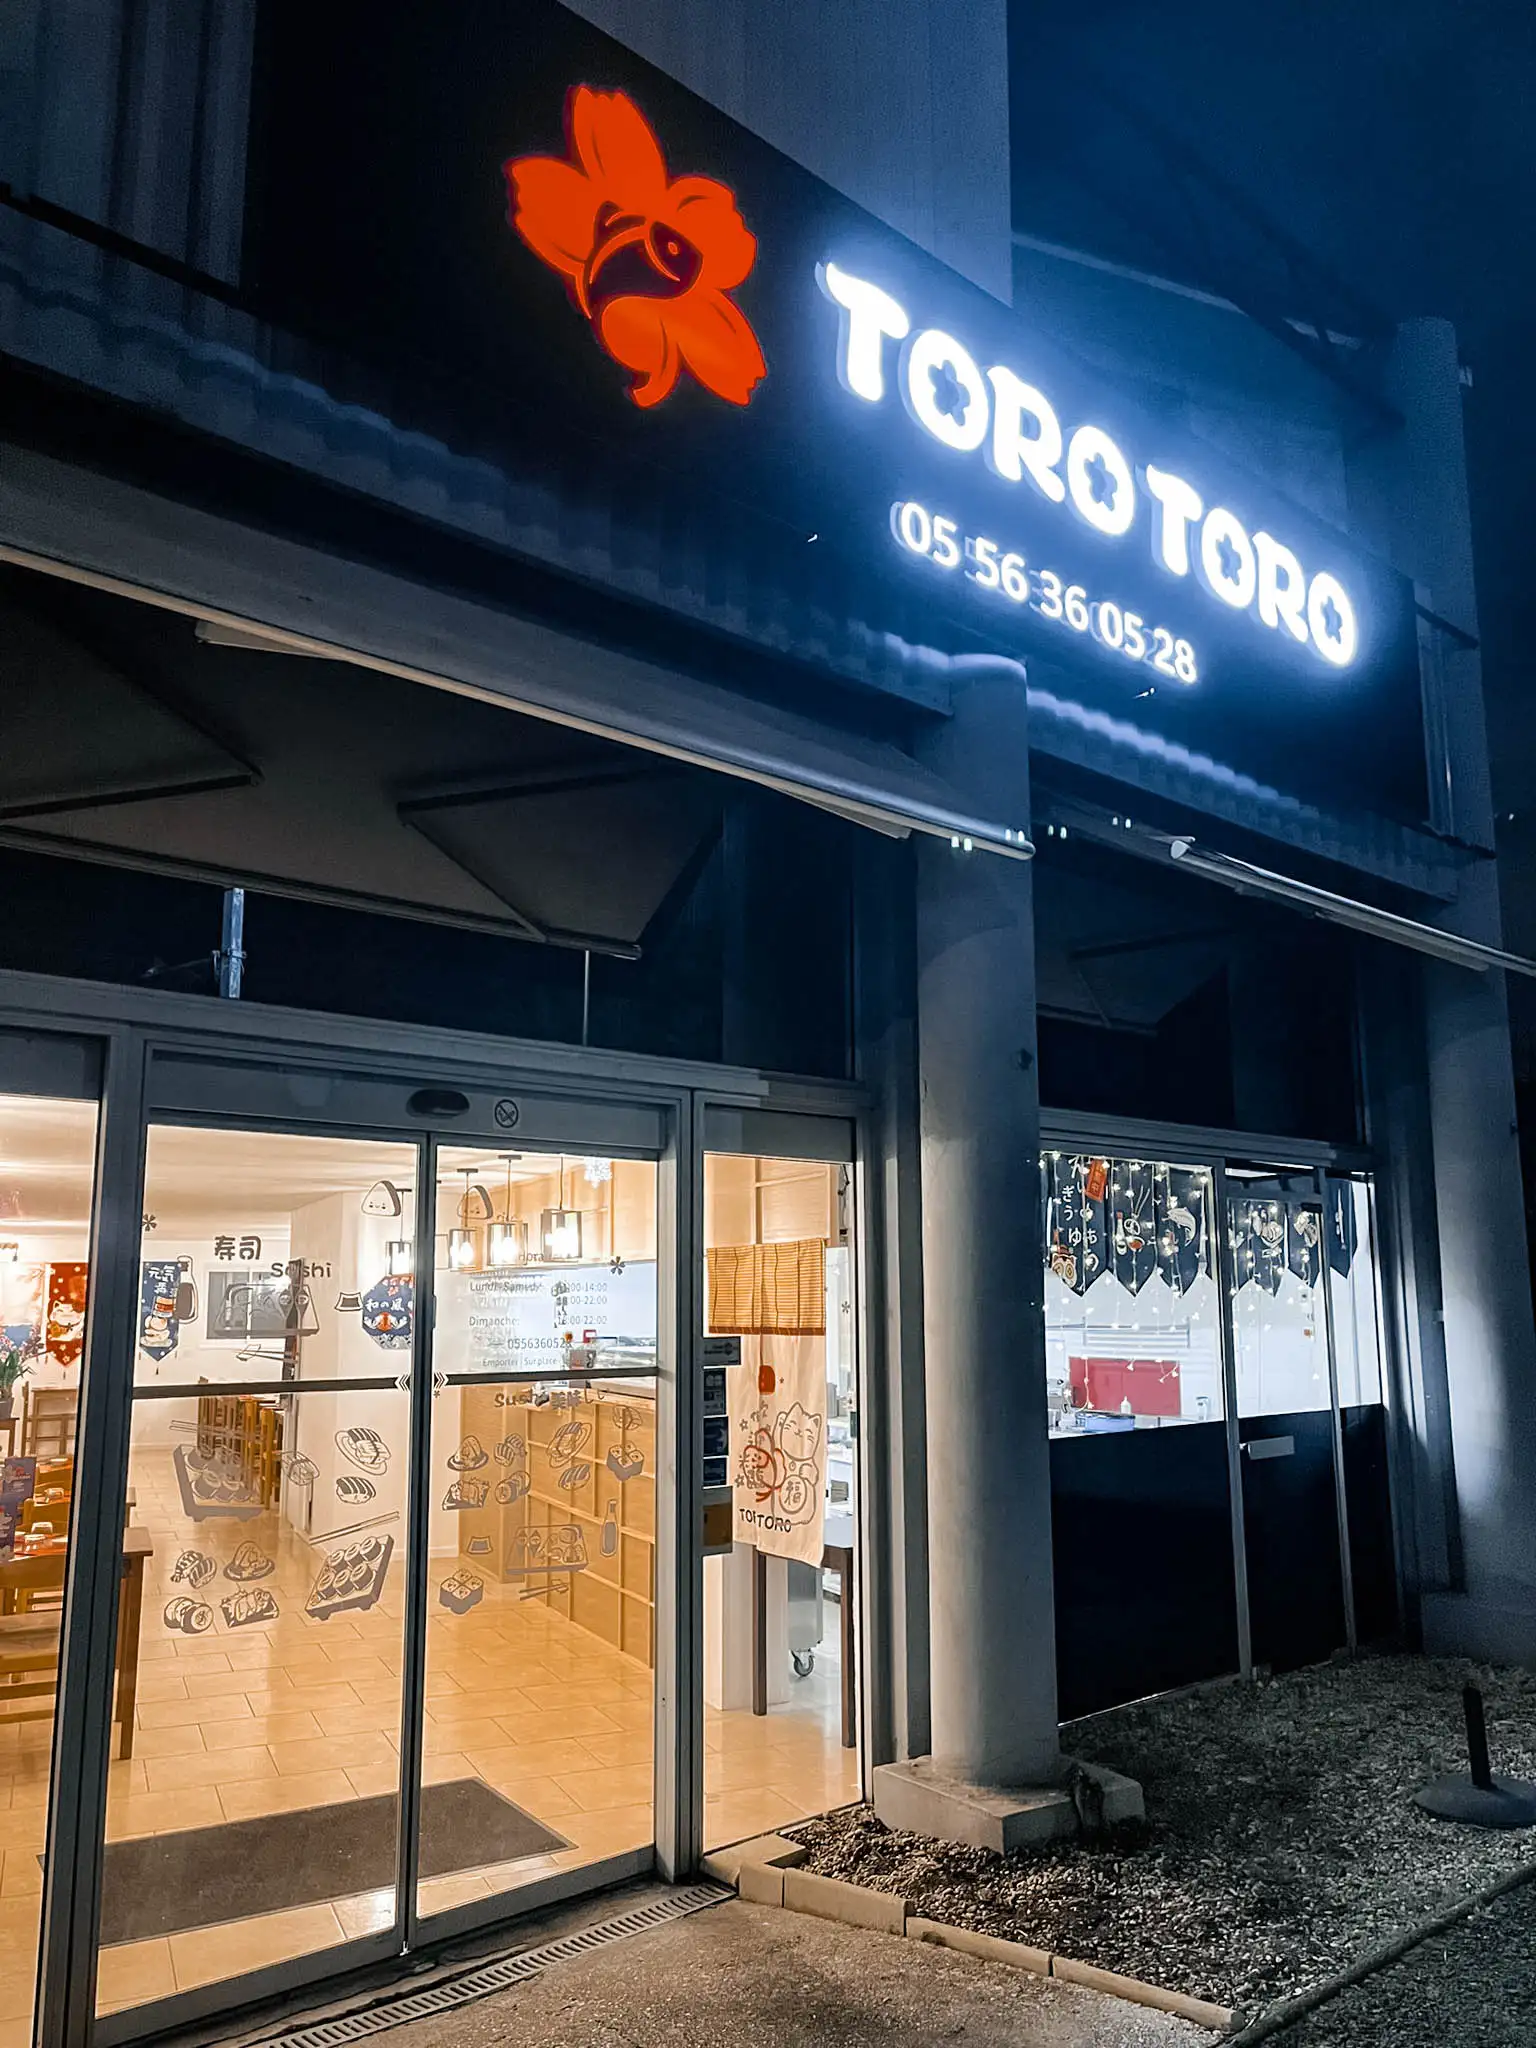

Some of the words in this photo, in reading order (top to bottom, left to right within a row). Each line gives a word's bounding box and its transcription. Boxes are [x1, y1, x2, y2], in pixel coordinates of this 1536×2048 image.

[822, 262, 1134, 535] TORO
[1142, 464, 1357, 667] TORO
[899, 501, 960, 567] 05
[974, 536, 1028, 602] 56
[1039, 570, 1090, 631] 36
[1097, 602, 1146, 659] 05
[1153, 628, 1197, 684] 28
[214, 1236, 262, 1260] 寿司
